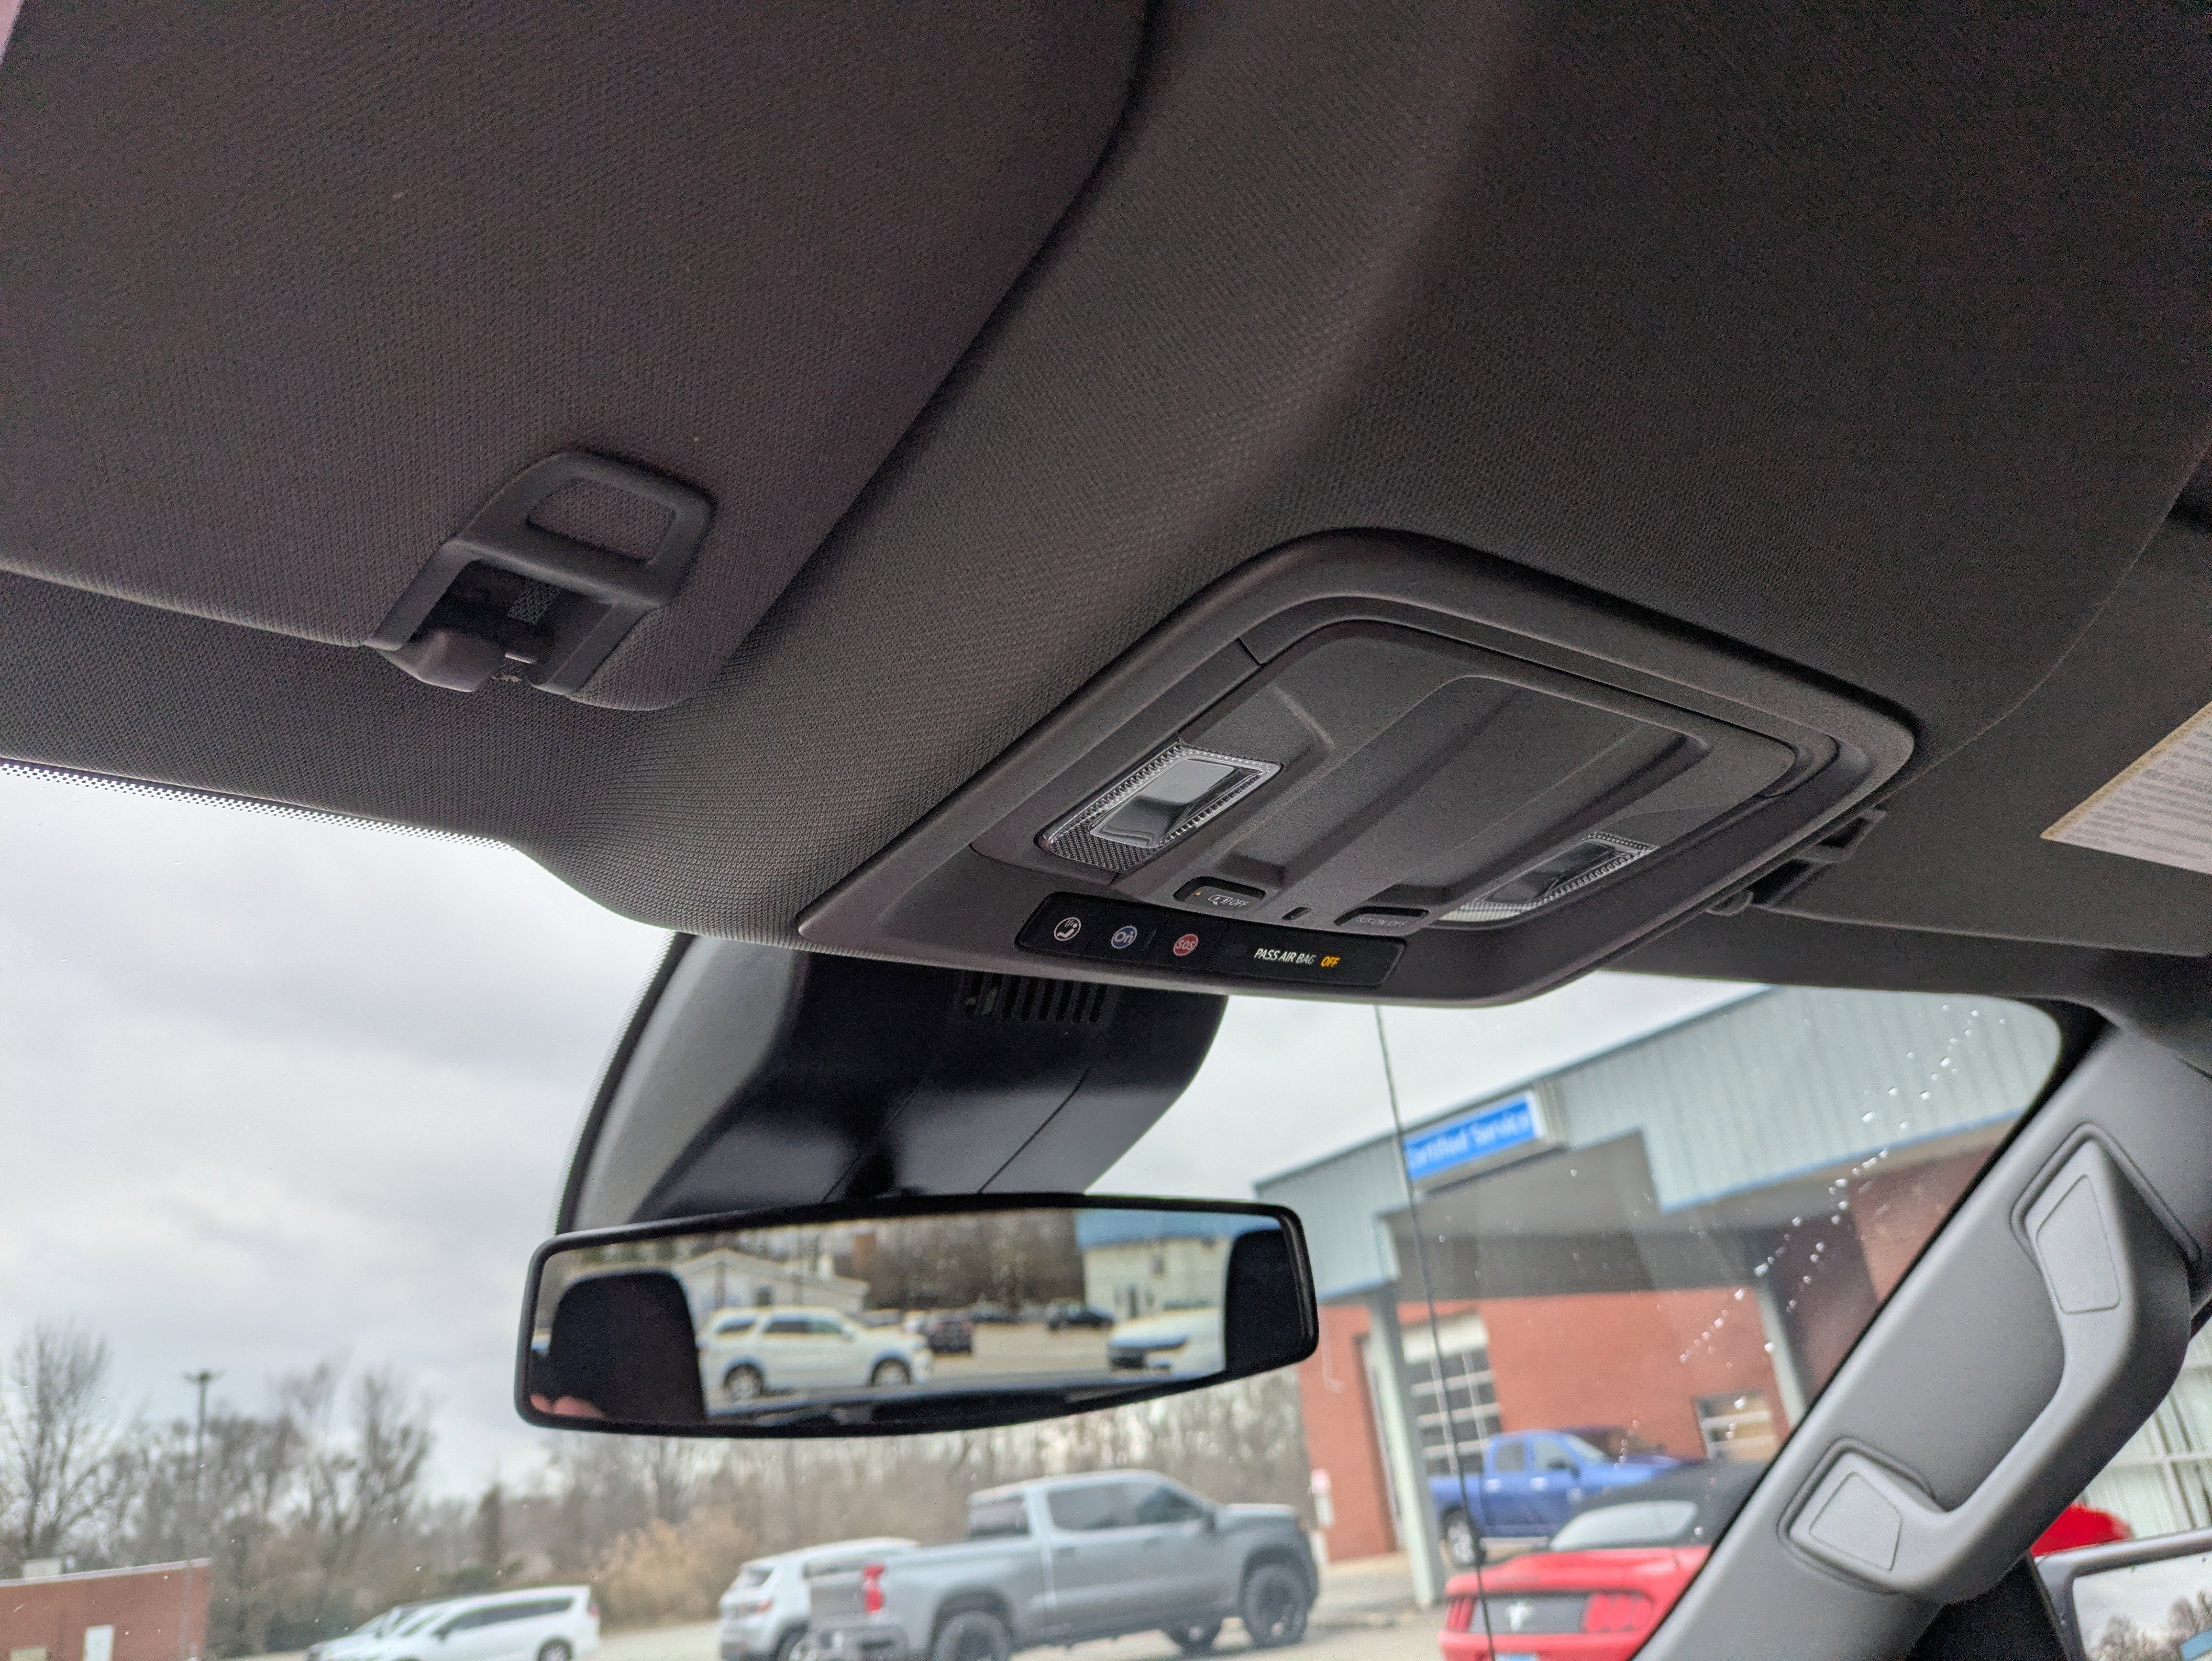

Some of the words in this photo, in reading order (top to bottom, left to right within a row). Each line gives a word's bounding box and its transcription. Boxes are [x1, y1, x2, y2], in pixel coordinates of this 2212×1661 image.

[1229, 899, 1250, 907] OFF
[1175, 939, 1196, 951] SOS
[1253, 948, 1281, 961] PASS
[1278, 951, 1297, 963] AIR
[1295, 953, 1316, 965] BAG
[1320, 955, 1340, 967] OFF
